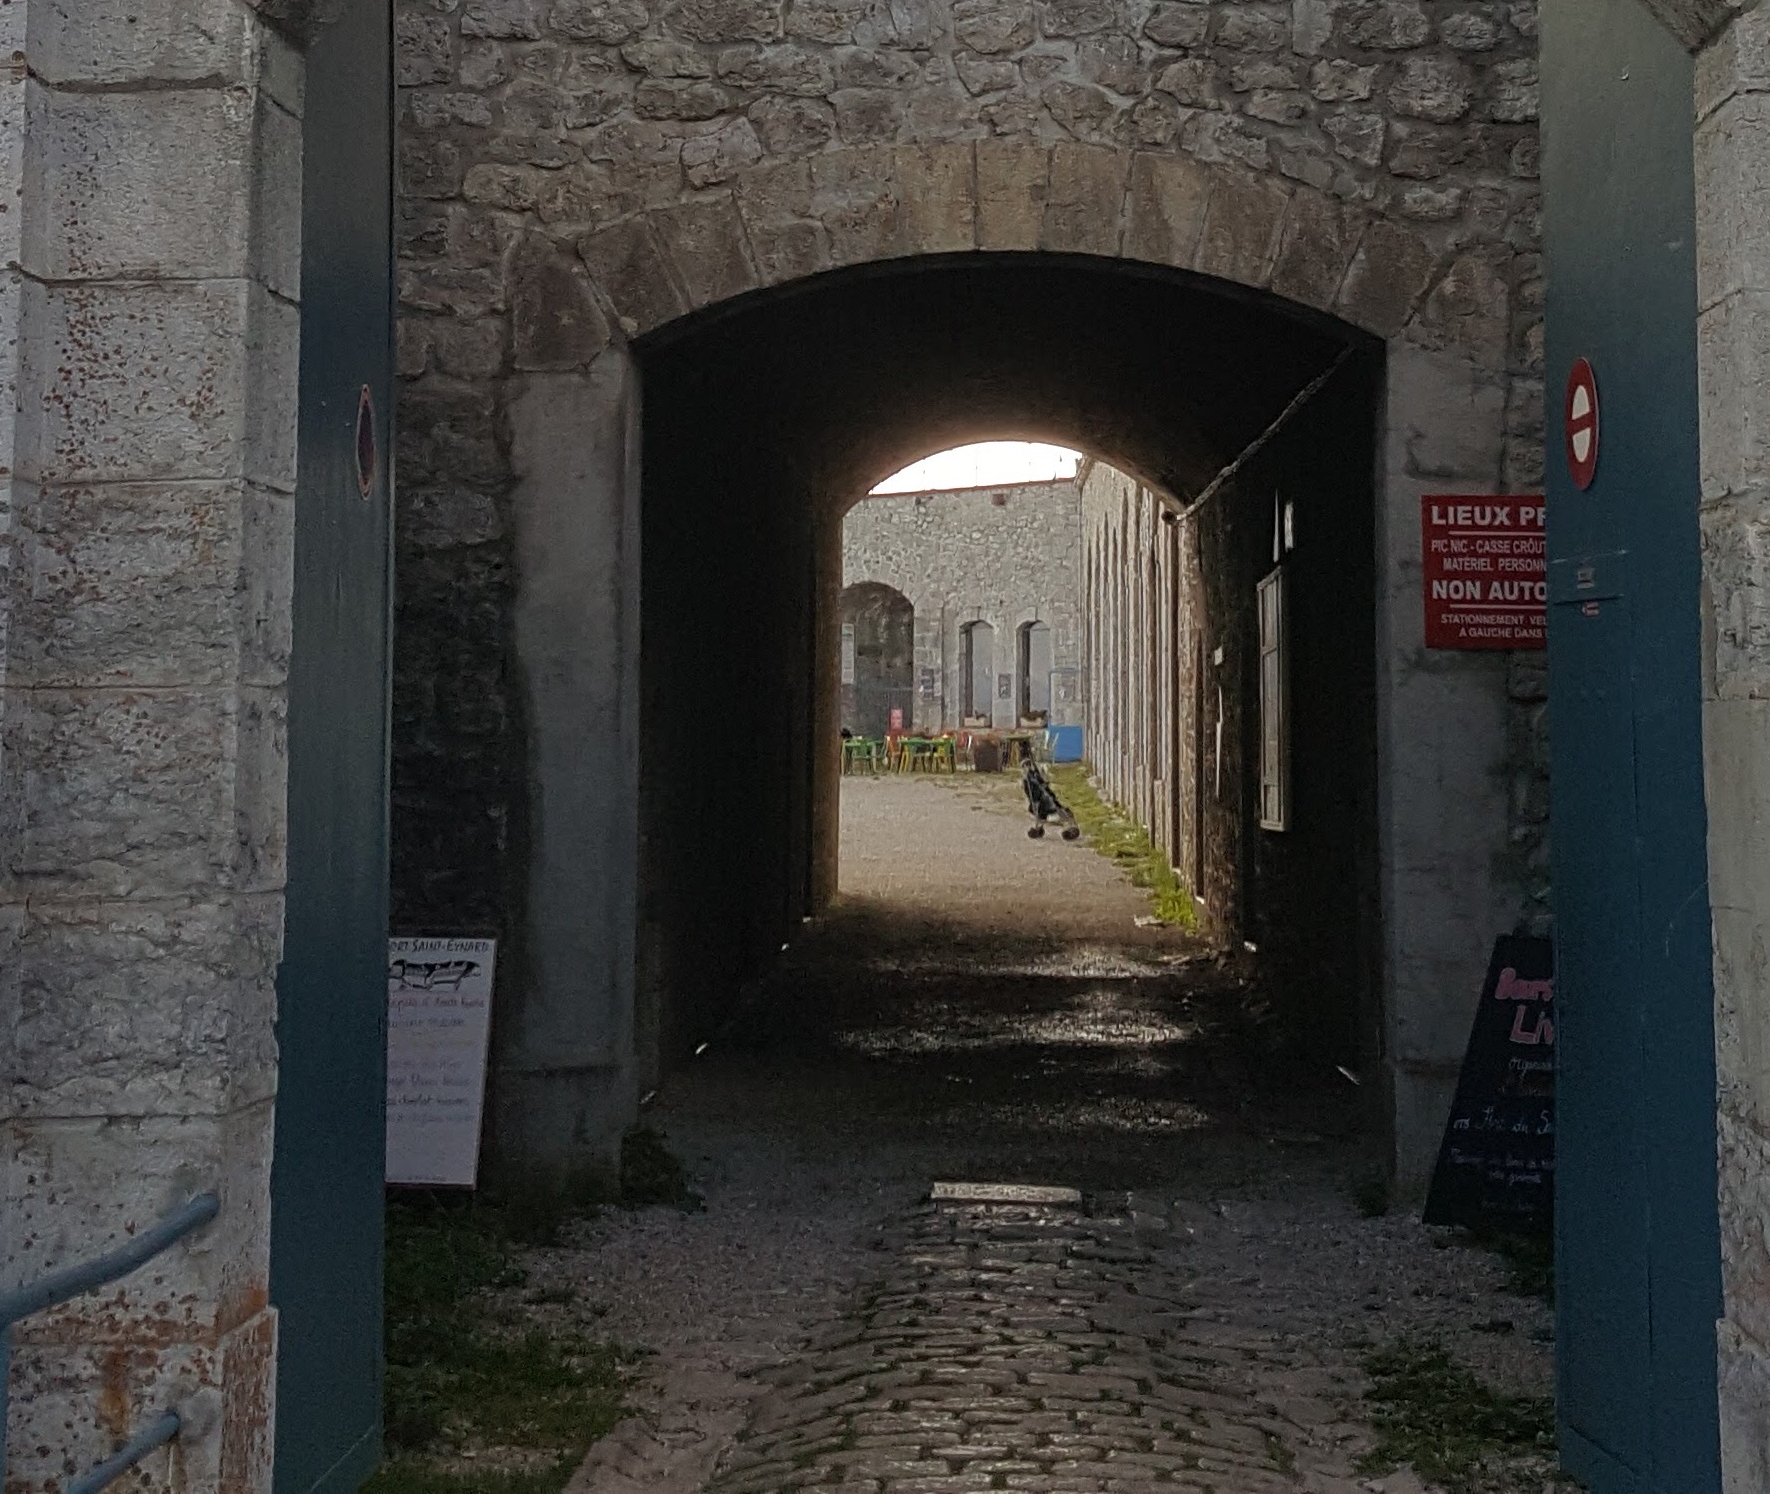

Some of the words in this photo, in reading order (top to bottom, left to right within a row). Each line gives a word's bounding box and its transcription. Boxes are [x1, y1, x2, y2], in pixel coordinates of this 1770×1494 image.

[1431, 505, 1511, 526] LIEUX
[1476, 540, 1510, 554] CASSE
[1432, 580, 1481, 600] NON
[1488, 581, 1546, 601] AUTO
[1441, 613, 1525, 625] STATIONNEMENT
[1469, 627, 1512, 638] GAUCHE
[1514, 628, 1543, 639] DANS
